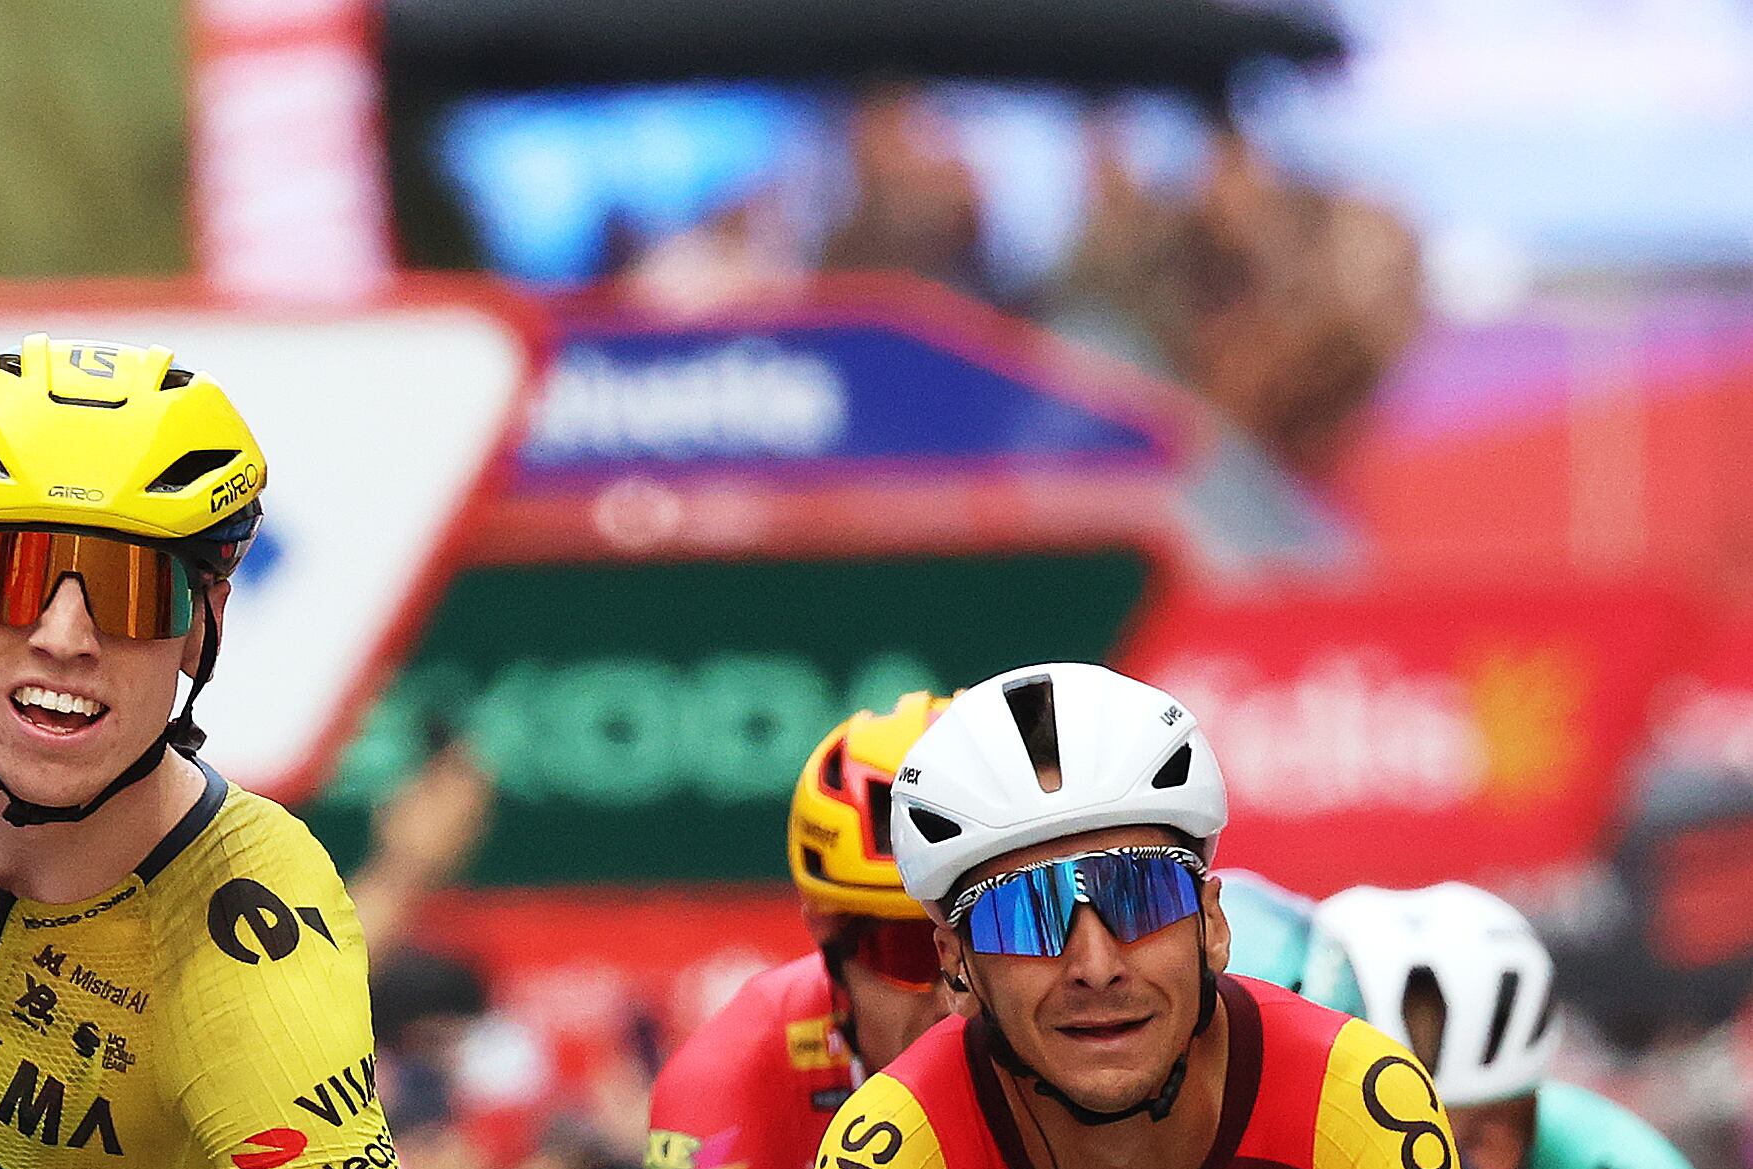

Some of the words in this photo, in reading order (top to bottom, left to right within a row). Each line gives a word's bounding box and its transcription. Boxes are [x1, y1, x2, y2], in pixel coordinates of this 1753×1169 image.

[47, 485, 104, 502] GIRO
[210, 463, 258, 513] GIRO
[69, 964, 130, 1007] Mistral
